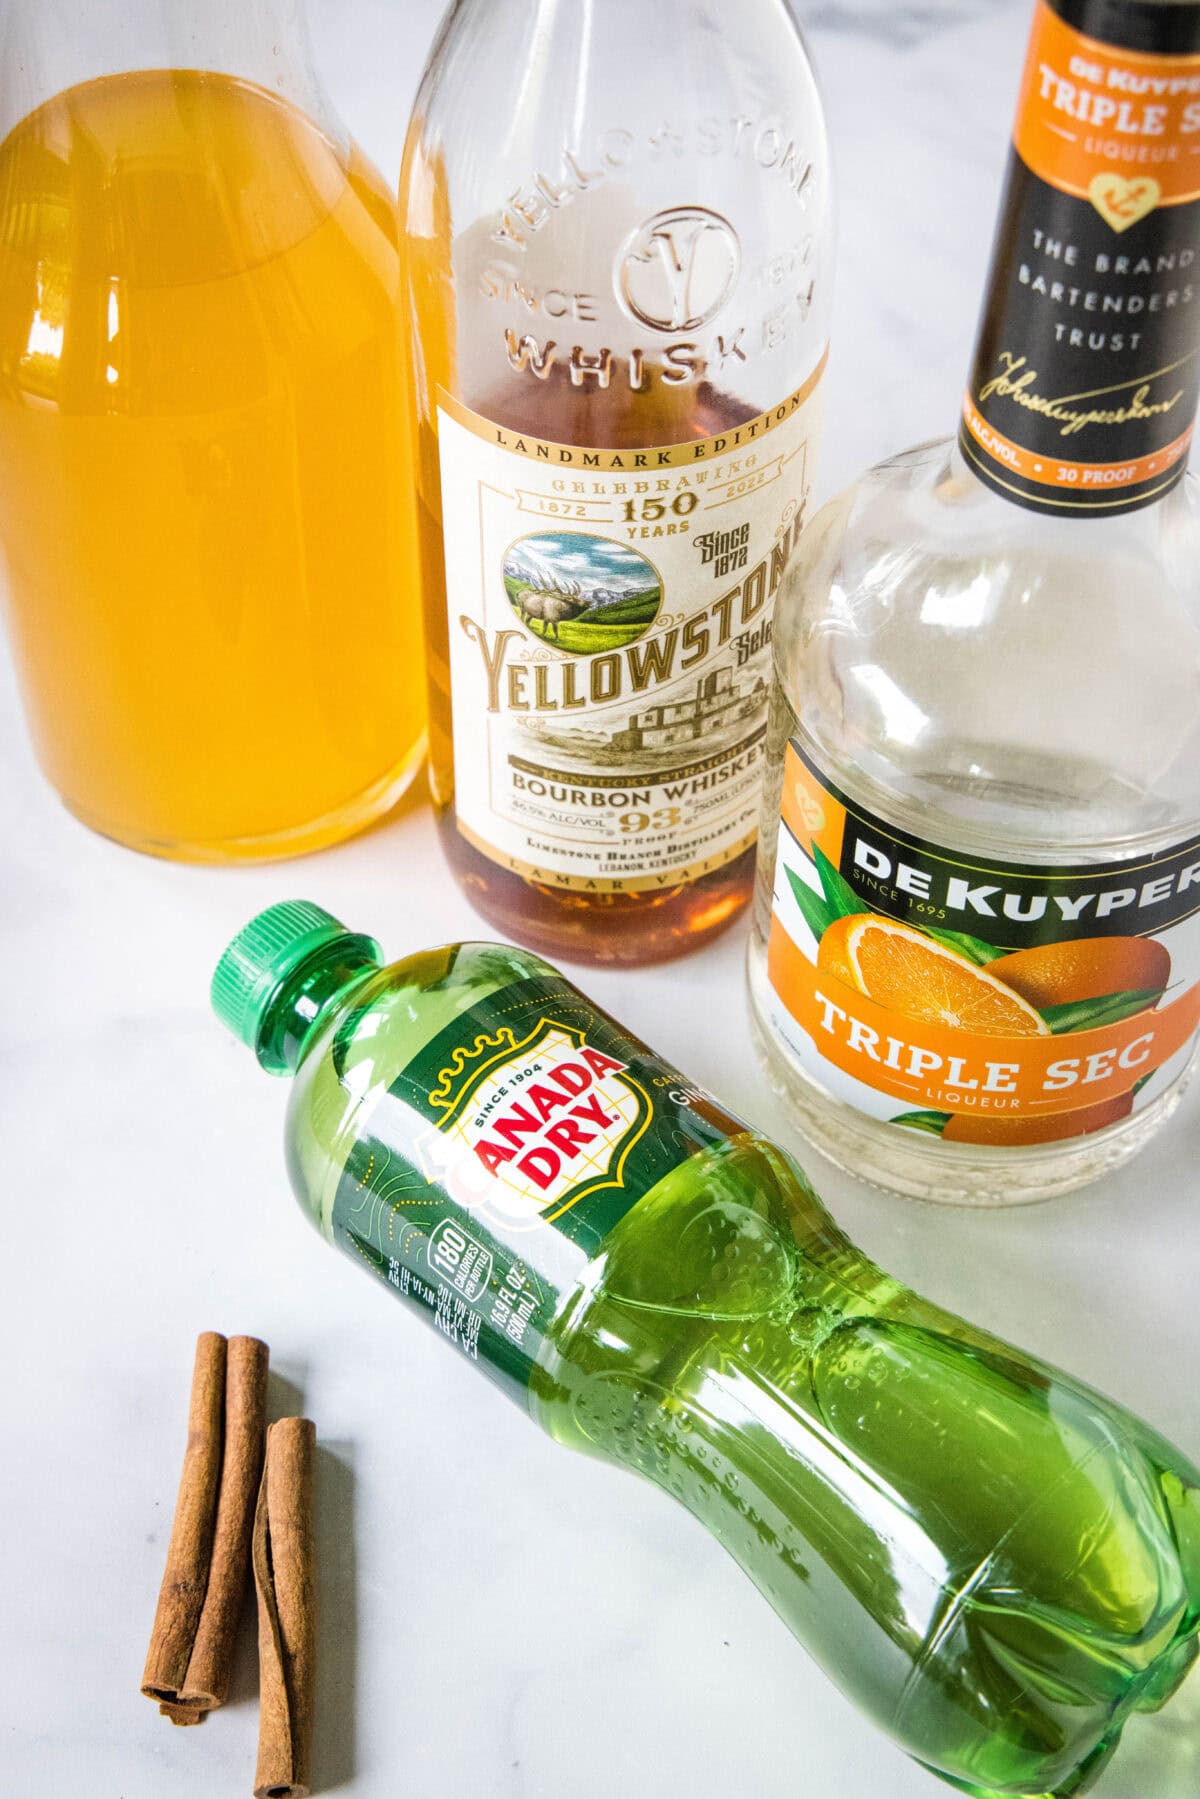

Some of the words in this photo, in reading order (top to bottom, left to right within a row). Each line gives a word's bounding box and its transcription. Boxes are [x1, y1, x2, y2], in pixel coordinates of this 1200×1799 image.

[1069, 56, 1103, 83] DE
[1039, 63, 1168, 135] TRIPLE
[1084, 136, 1178, 163] LIQUEUR
[1033, 229, 1079, 266] THE
[1096, 250, 1195, 275] BRAND
[1018, 264, 1194, 314] BARTENDERS
[1055, 324, 1142, 351] TRUST
[496, 431, 672, 467] LANDMARK
[693, 393, 802, 459] EDITION
[551, 455, 758, 495] CELEBRATING
[726, 472, 767, 498] 2022
[1057, 467, 1078, 481] 30
[1082, 467, 1136, 484] PROOF
[536, 500, 587, 516] 1872
[620, 491, 700, 523] 150
[627, 520, 690, 539] YEARS
[693, 522, 750, 565] Since
[714, 544, 748, 579] 1872
[512, 772, 650, 808] BOURBON
[662, 742, 765, 801] WHISKEY
[618, 806, 681, 834] 93
[510, 858, 624, 890] LAMAR
[853, 837, 932, 900] DE
[852, 868, 898, 902] SINCE
[908, 898, 947, 920] 1695
[813, 990, 1020, 1093] TRIPLE
[1041, 1032, 1155, 1090] SEC
[474, 1086, 509, 1128] SINCE
[508, 1063, 542, 1086] 1904
[926, 1089, 1020, 1109] LIQUEUR
[516, 1092, 614, 1191] DRY
[433, 1227, 466, 1274] 180
[454, 1243, 479, 1289] CALORIES
[470, 1252, 490, 1283] BOTTLE
[506, 1267, 526, 1290] OZ
[464, 1279, 477, 1298] PER
[498, 1287, 517, 1306] FL
[490, 1300, 510, 1328] 16.9
